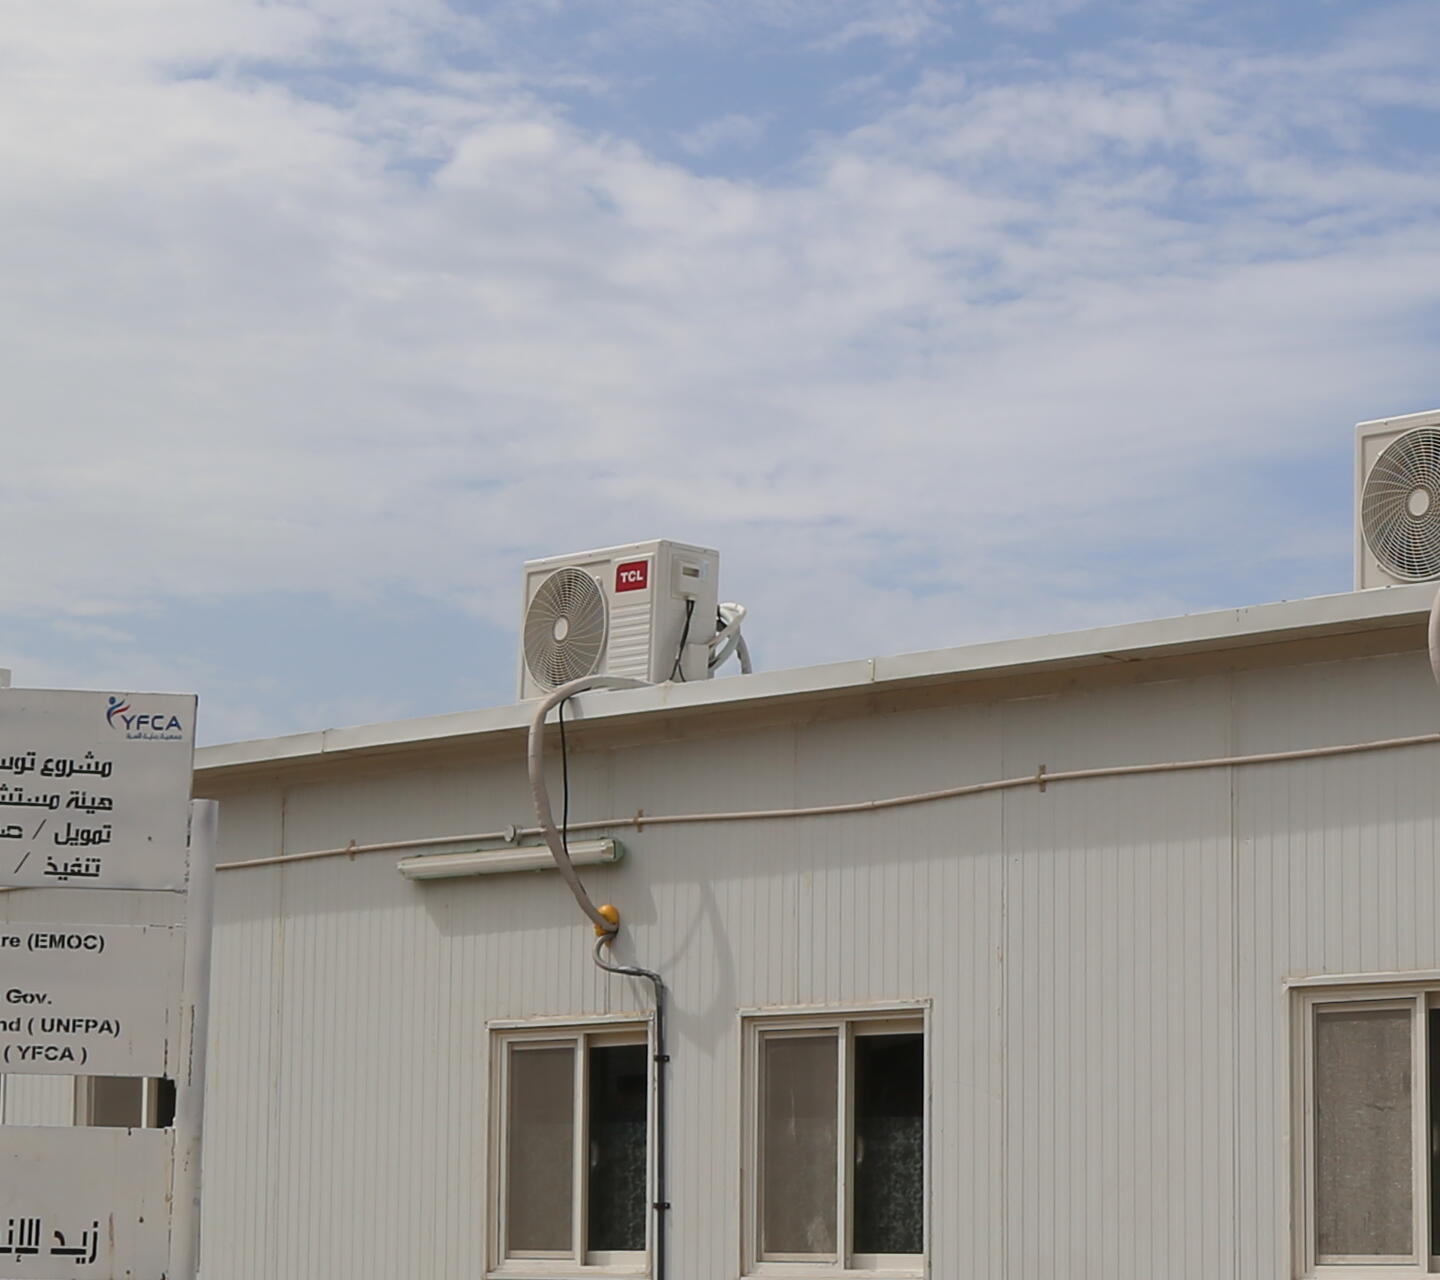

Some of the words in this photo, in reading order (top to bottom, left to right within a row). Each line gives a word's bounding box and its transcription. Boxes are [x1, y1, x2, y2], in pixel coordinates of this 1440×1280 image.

[620, 570, 644, 583] TCL
[121, 714, 181, 731] YFCA
[41, 751, 112, 777] مشروع
[66, 790, 113, 814] هيئة
[54, 822, 112, 846] تمويل
[44, 856, 101, 881] تنفيذ
[27, 933, 105, 953] (EMOC)
[5, 988, 52, 1005] Gov.
[50, 1220, 98, 1264] زيد
